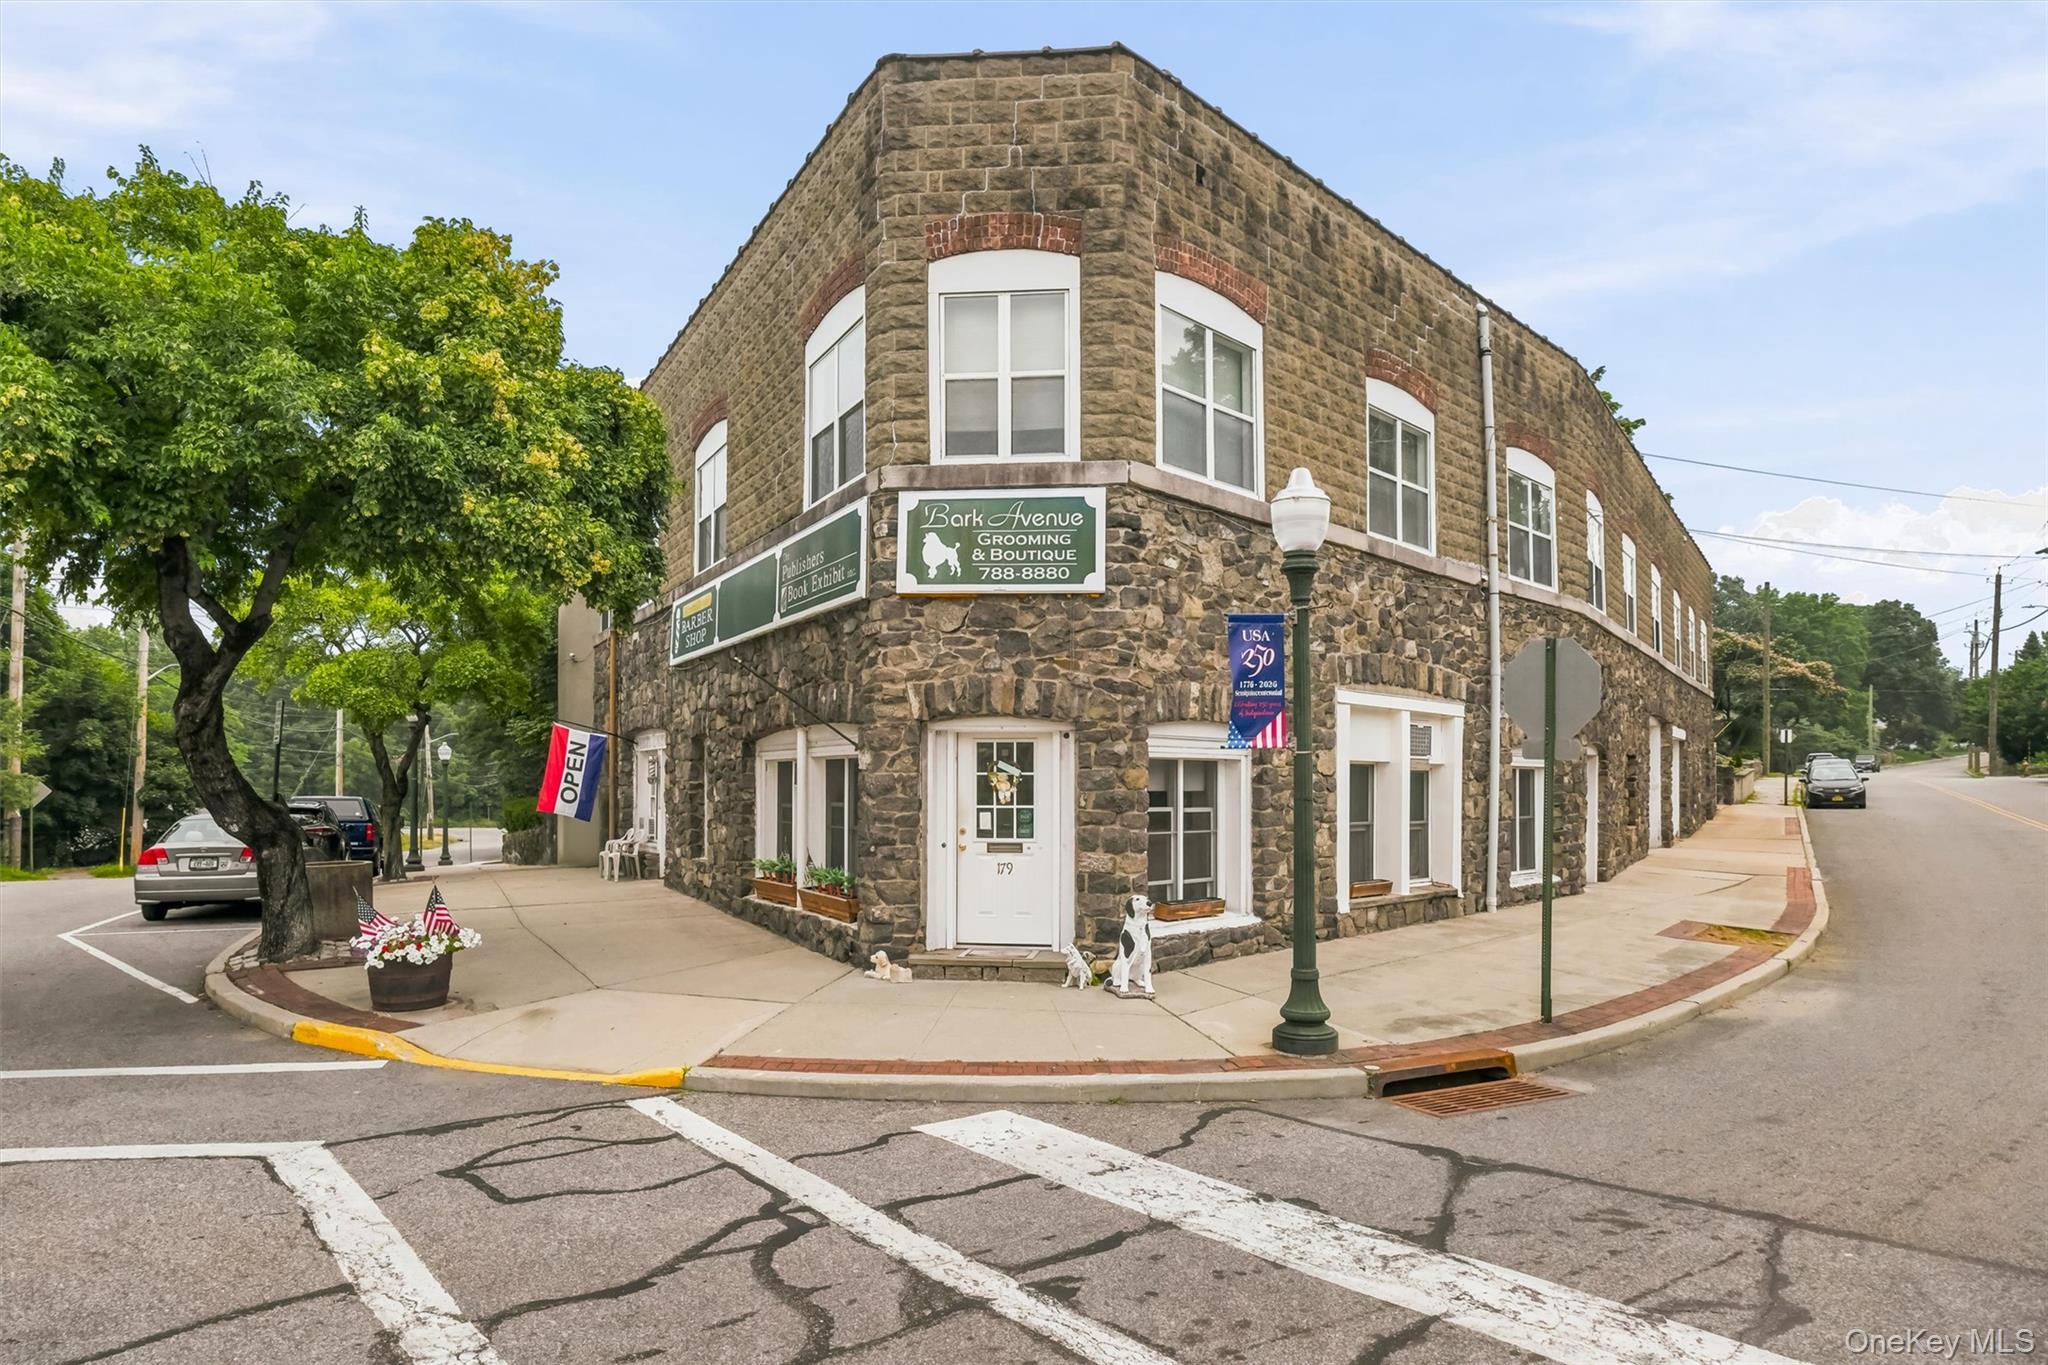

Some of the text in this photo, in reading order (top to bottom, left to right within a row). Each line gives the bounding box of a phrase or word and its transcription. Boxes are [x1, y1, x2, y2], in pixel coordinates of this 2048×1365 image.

[920, 500, 1084, 529] Bark Avenue
[977, 533, 1072, 546] GROOMING
[782, 551, 825, 582] Publishers
[972, 548, 1077, 562] & BOUTIQUE
[787, 580, 808, 602] Book
[811, 563, 845, 593] Exhibit
[978, 567, 1070, 580] 788-8880
[681, 608, 713, 634] BARBER
[685, 627, 707, 648] SHOP
[1242, 629, 1270, 642] USA
[1241, 644, 1275, 678] 250
[560, 740, 587, 804] OPEN
[997, 862, 1014, 875] 179
